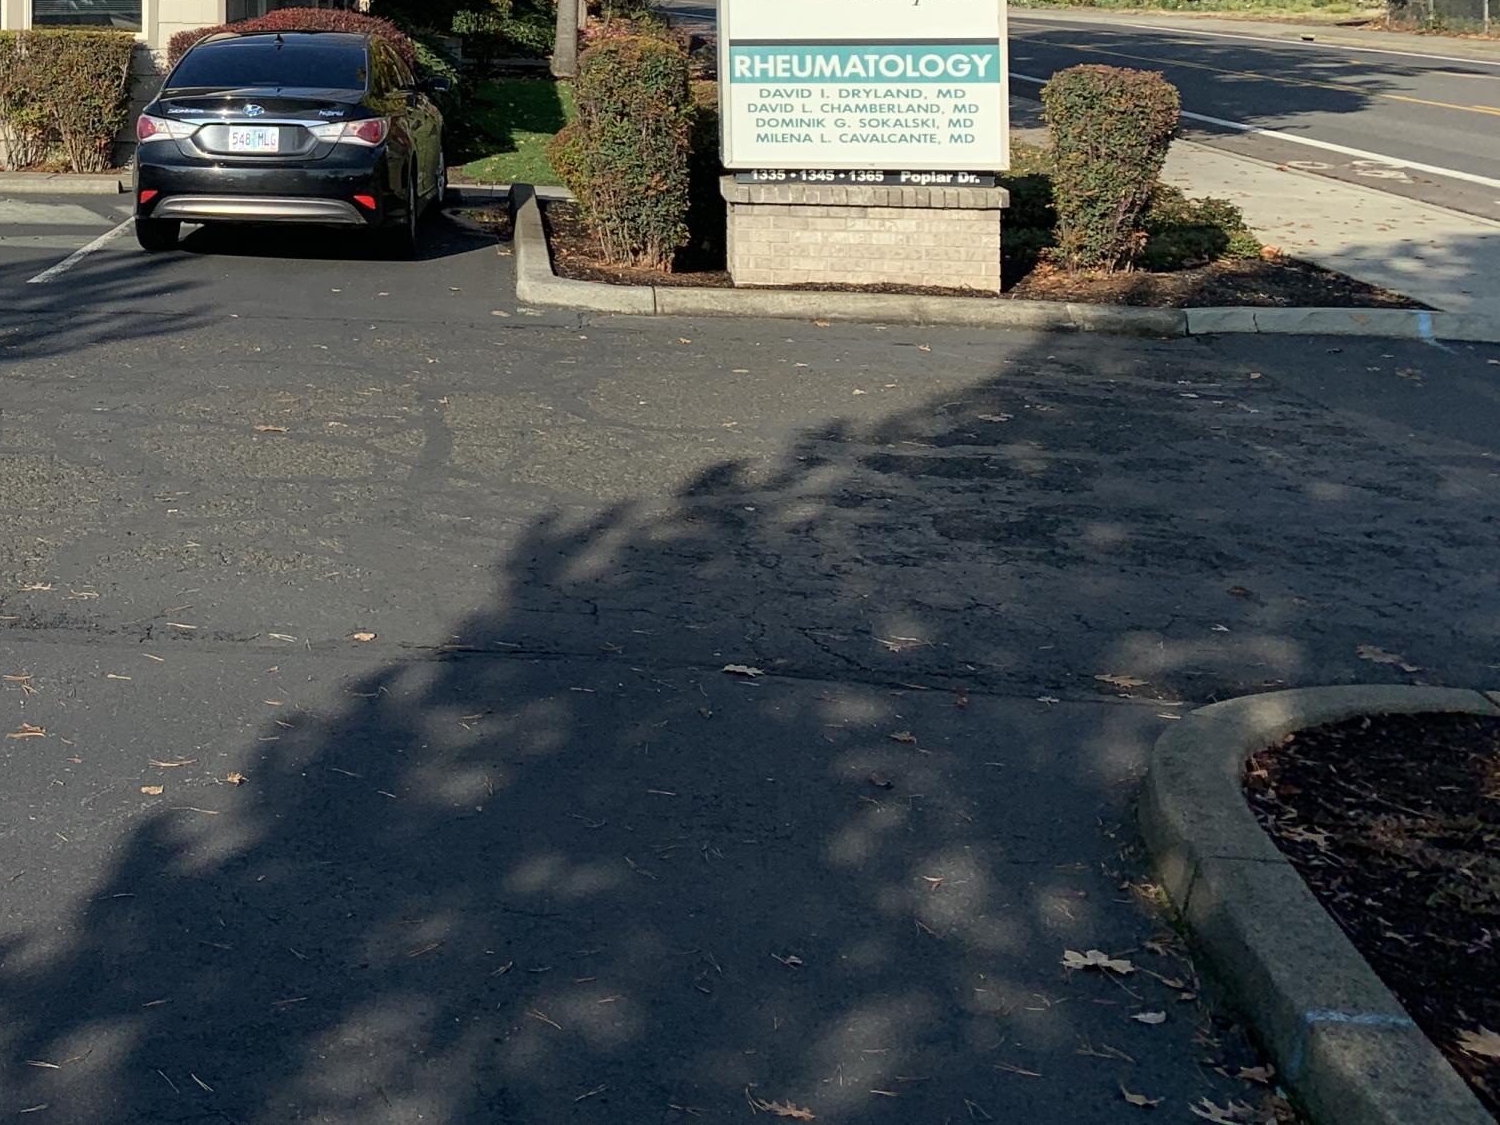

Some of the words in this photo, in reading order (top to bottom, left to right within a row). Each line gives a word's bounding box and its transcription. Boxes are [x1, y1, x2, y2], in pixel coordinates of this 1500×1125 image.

[734, 53, 993, 78] RHEUMATOLOGY
[759, 88, 812, 99] DAVID
[838, 88, 928, 100] DRYLAND,
[936, 88, 966, 99] MD
[747, 103, 795, 113] DAVID
[801, 103, 813, 113] L.
[820, 103, 945, 115] CHAMBERLAND,
[952, 103, 980, 114] MD
[755, 118, 826, 128] DOMINIK
[833, 118, 851, 128] G.
[859, 118, 940, 130] SOKALSKI,
[947, 118, 974, 128] MD
[232, 132, 251, 146] 548
[756, 133, 813, 143] MILENA
[820, 133, 832, 143] L.
[838, 133, 941, 145] CAVALCANTE,
[949, 133, 976, 144] MD
[751, 170, 786, 180] 1335
[800, 170, 835, 181] 1345
[849, 170, 884, 182] 1365
[957, 172, 980, 184] Dr.
